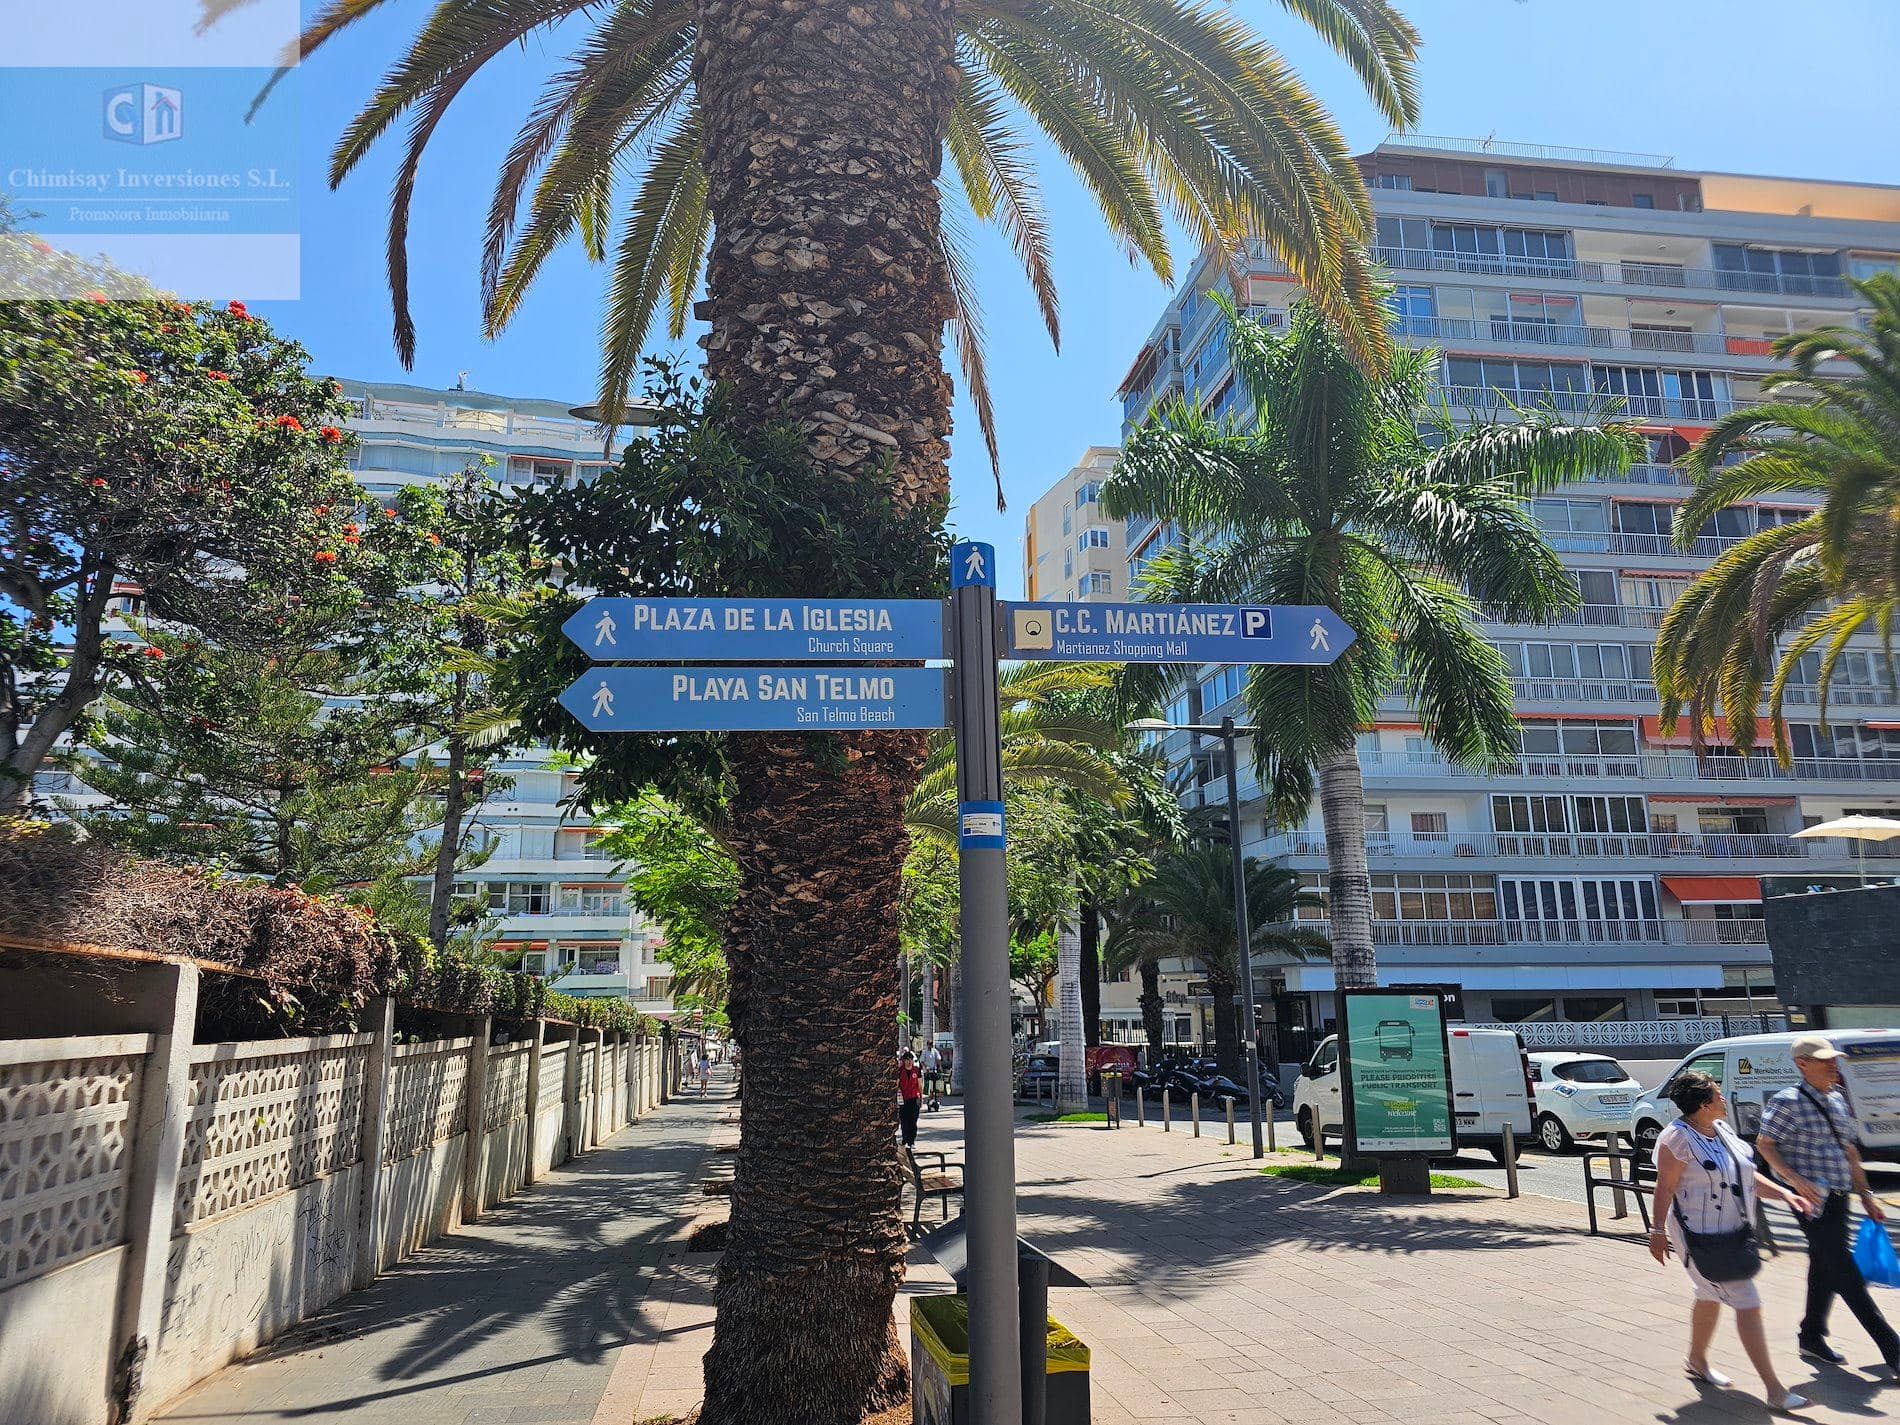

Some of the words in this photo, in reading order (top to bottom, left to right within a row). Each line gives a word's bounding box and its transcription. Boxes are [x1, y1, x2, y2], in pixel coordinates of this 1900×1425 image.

[633, 604, 716, 631] PLAZA
[724, 608, 755, 631] DE
[764, 608, 794, 631] LA
[803, 605, 893, 631] IGLESIA
[1056, 608, 1098, 635] C.C.
[1106, 607, 1235, 636] MARTIÁNEZ
[1246, 611, 1266, 636] P
[808, 638, 850, 653] Church
[853, 638, 894, 655] Square
[1057, 640, 1111, 656] Martianez
[1113, 640, 1163, 658] Shopping
[1166, 641, 1188, 656] Mall
[673, 674, 749, 702] PLAYA
[758, 674, 807, 701] SAN
[815, 674, 895, 701] TELMO
[797, 707, 820, 722] San
[822, 707, 857, 722] Telmo
[860, 706, 895, 722] Beach
[1391, 1081, 1438, 1089] TRANSPORT
